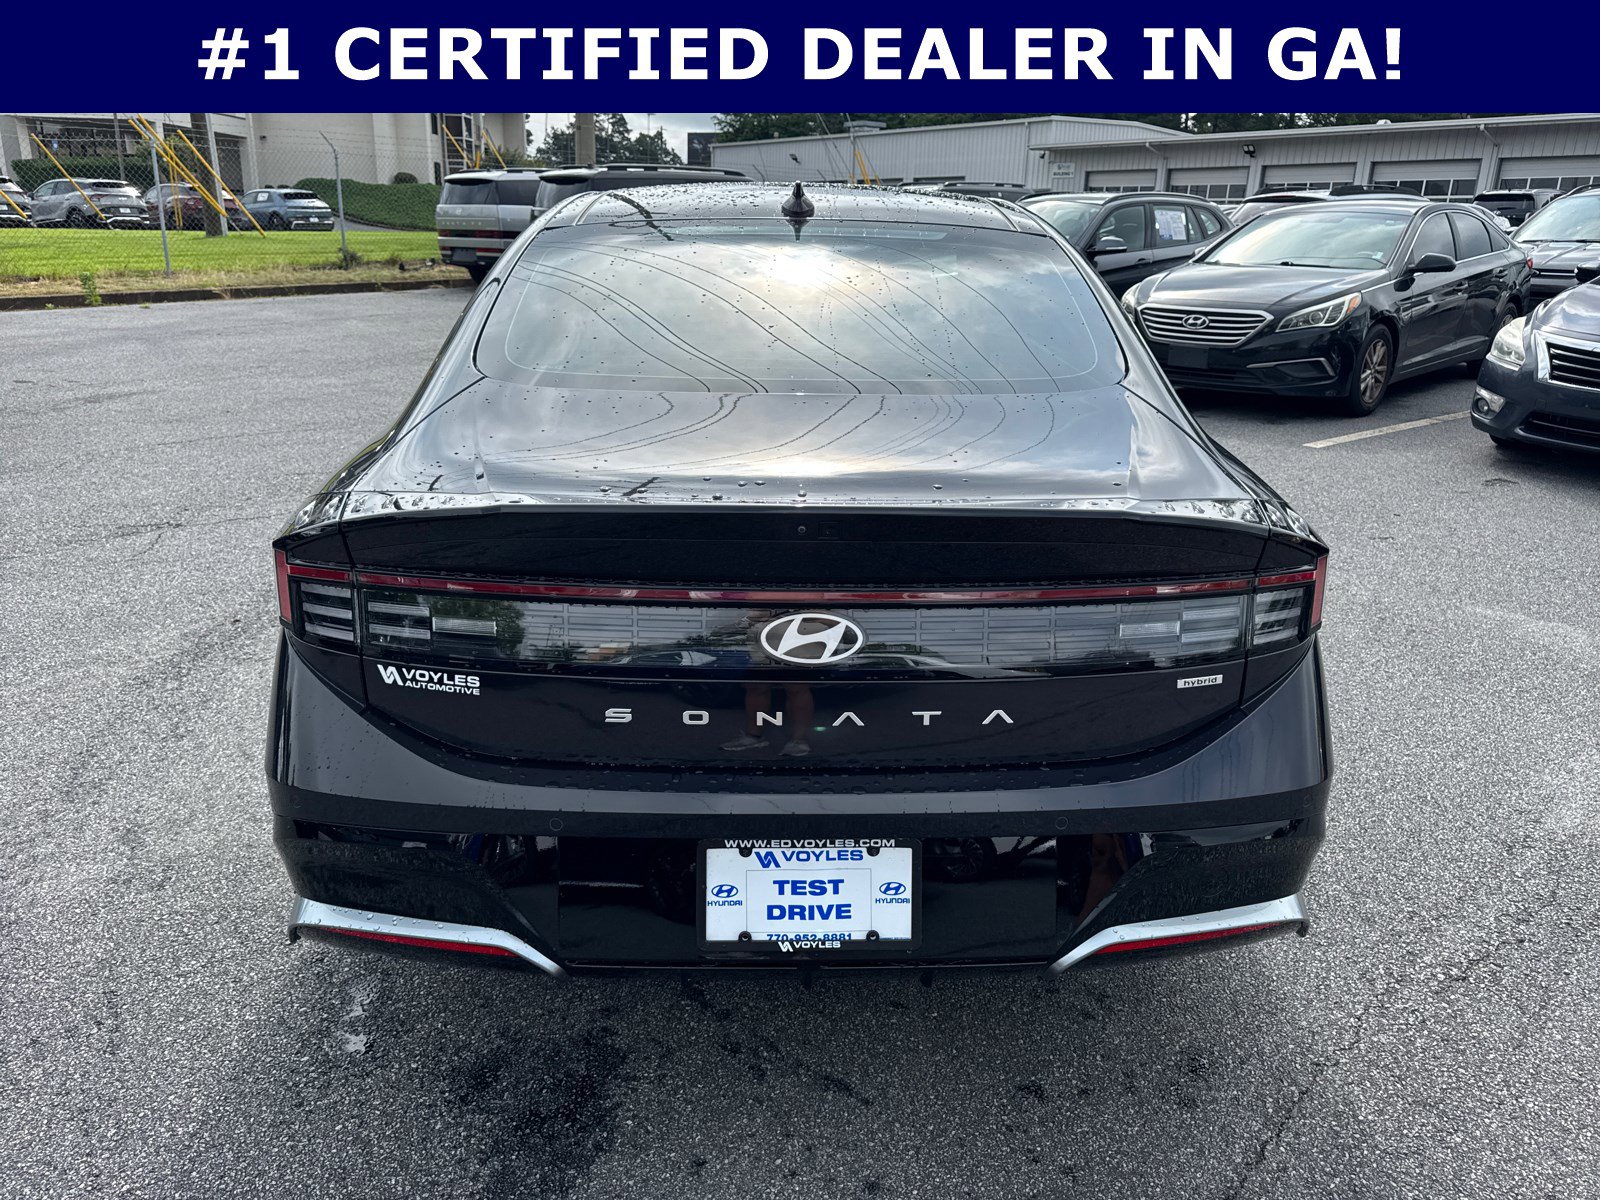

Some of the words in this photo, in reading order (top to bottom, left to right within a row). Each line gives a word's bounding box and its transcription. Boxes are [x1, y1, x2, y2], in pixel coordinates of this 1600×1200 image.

[401, 667, 481, 688] VOYLES
[1183, 676, 1218, 687] hybrid
[404, 680, 481, 696] AUTOMOTIVE
[604, 707, 1014, 727] SONATA
[780, 849, 864, 862] VOYLES
[772, 878, 845, 896] TEST
[766, 903, 852, 921] DRIVE
[792, 940, 842, 949] VOYLES
